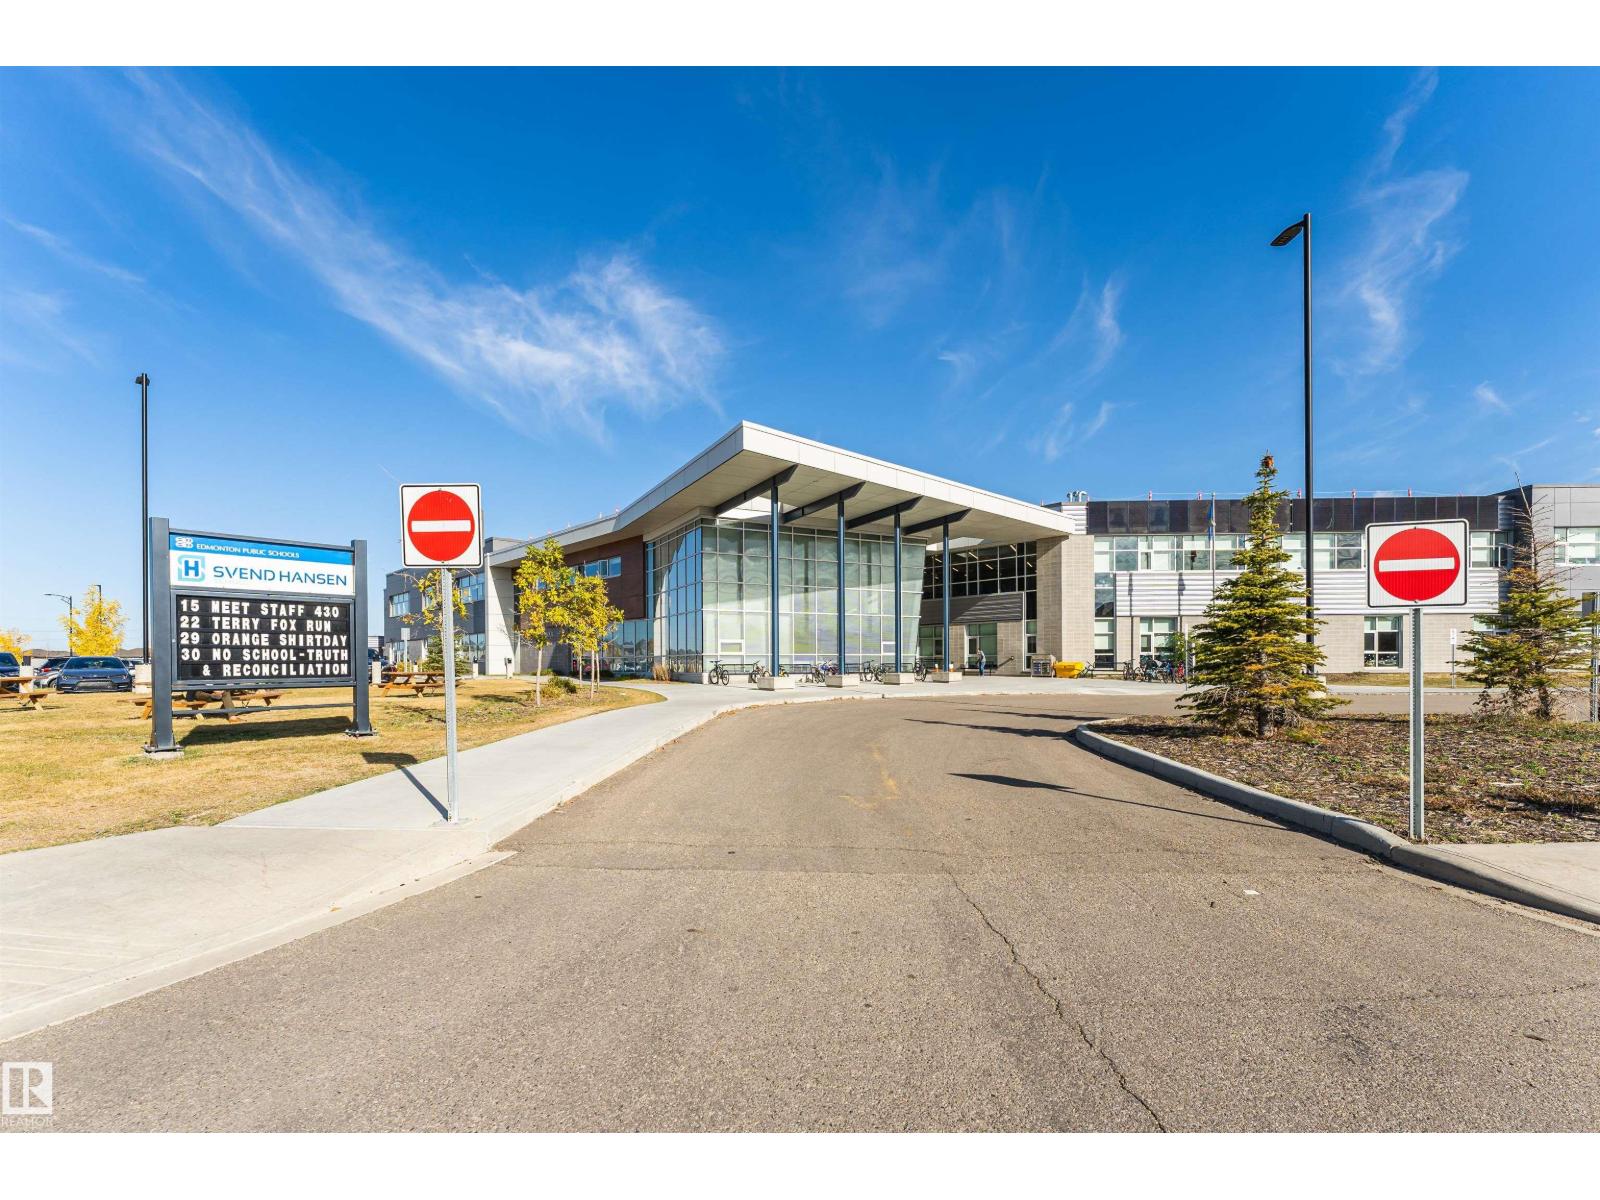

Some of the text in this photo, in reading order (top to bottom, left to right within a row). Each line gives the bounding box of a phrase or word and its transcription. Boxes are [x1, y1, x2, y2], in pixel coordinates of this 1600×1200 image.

[196, 543, 300, 558] EDMONTON PUBLIC SCHOOLS
[213, 566, 347, 586] SVEND HANSEN
[180, 599, 339, 618] 15 MEET STAFF 430
[180, 616, 331, 632] 22 TERRY FOX RUN
[180, 632, 200, 645] 29
[211, 633, 269, 646] ORANGE
[181, 648, 348, 661] 30 NO SCHOOL-TRUTH
[202, 663, 348, 677] & RECONCILIATION
